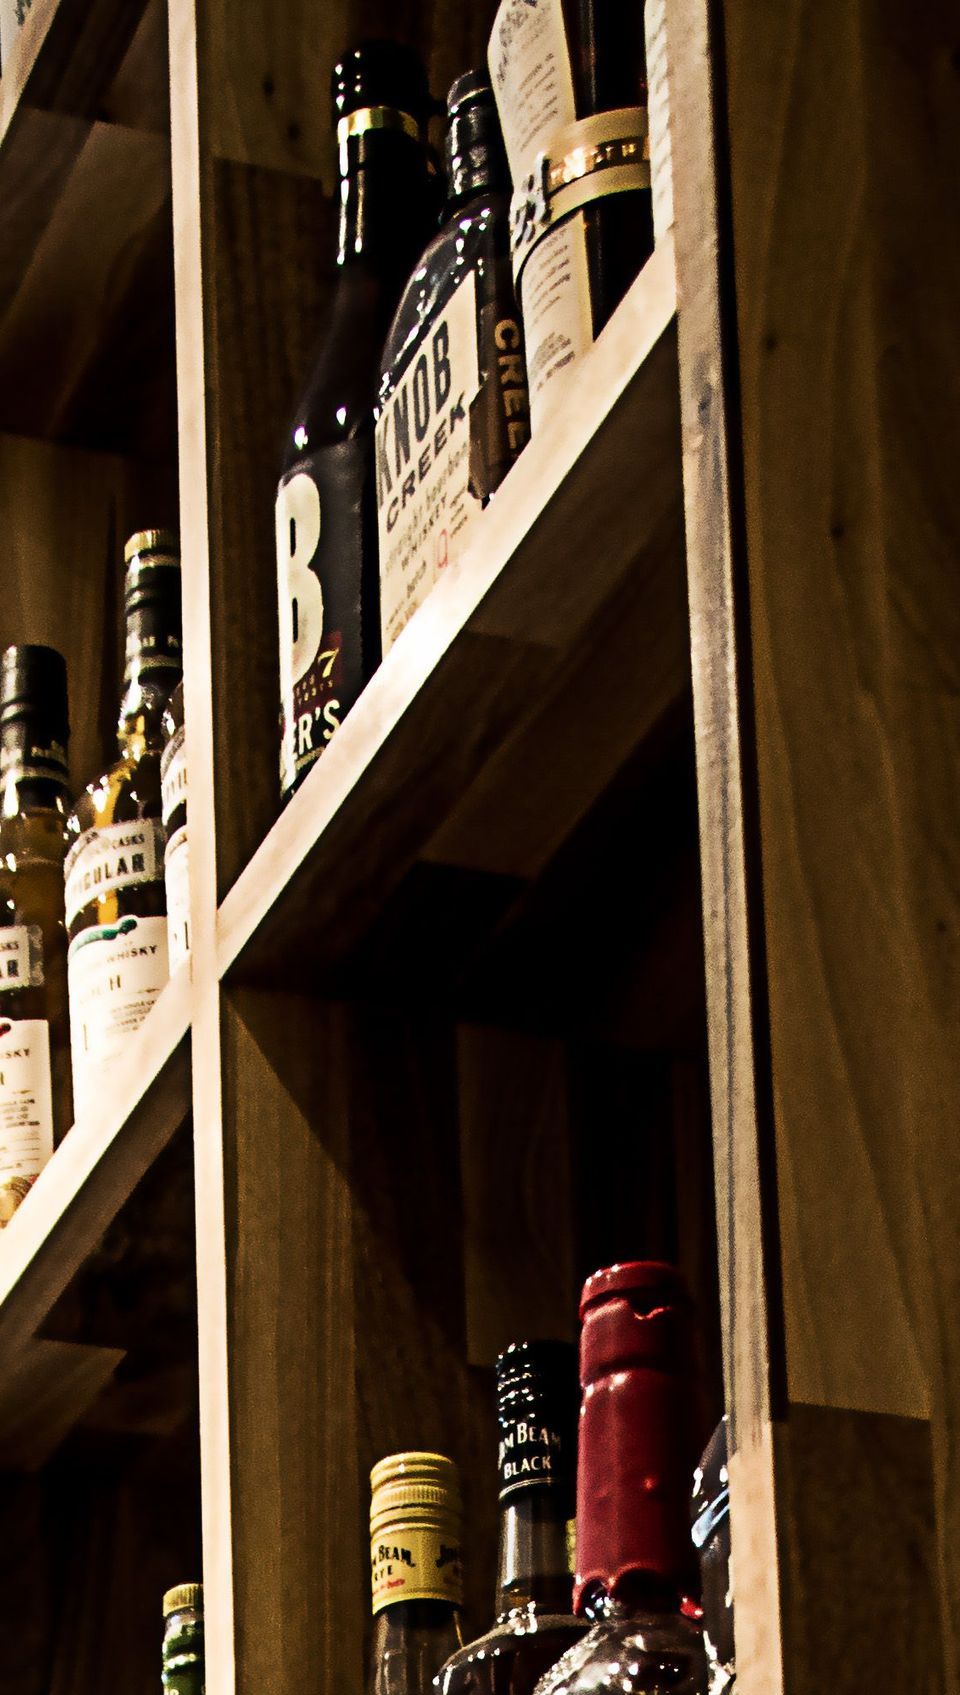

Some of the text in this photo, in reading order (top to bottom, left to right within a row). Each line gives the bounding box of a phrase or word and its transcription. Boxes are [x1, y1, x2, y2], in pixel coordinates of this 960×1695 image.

[377, 320, 451, 510] KNOB
[386, 390, 466, 533] CREEK
[318, 647, 340, 678] 7
[503, 1456, 552, 1480] BLACK
